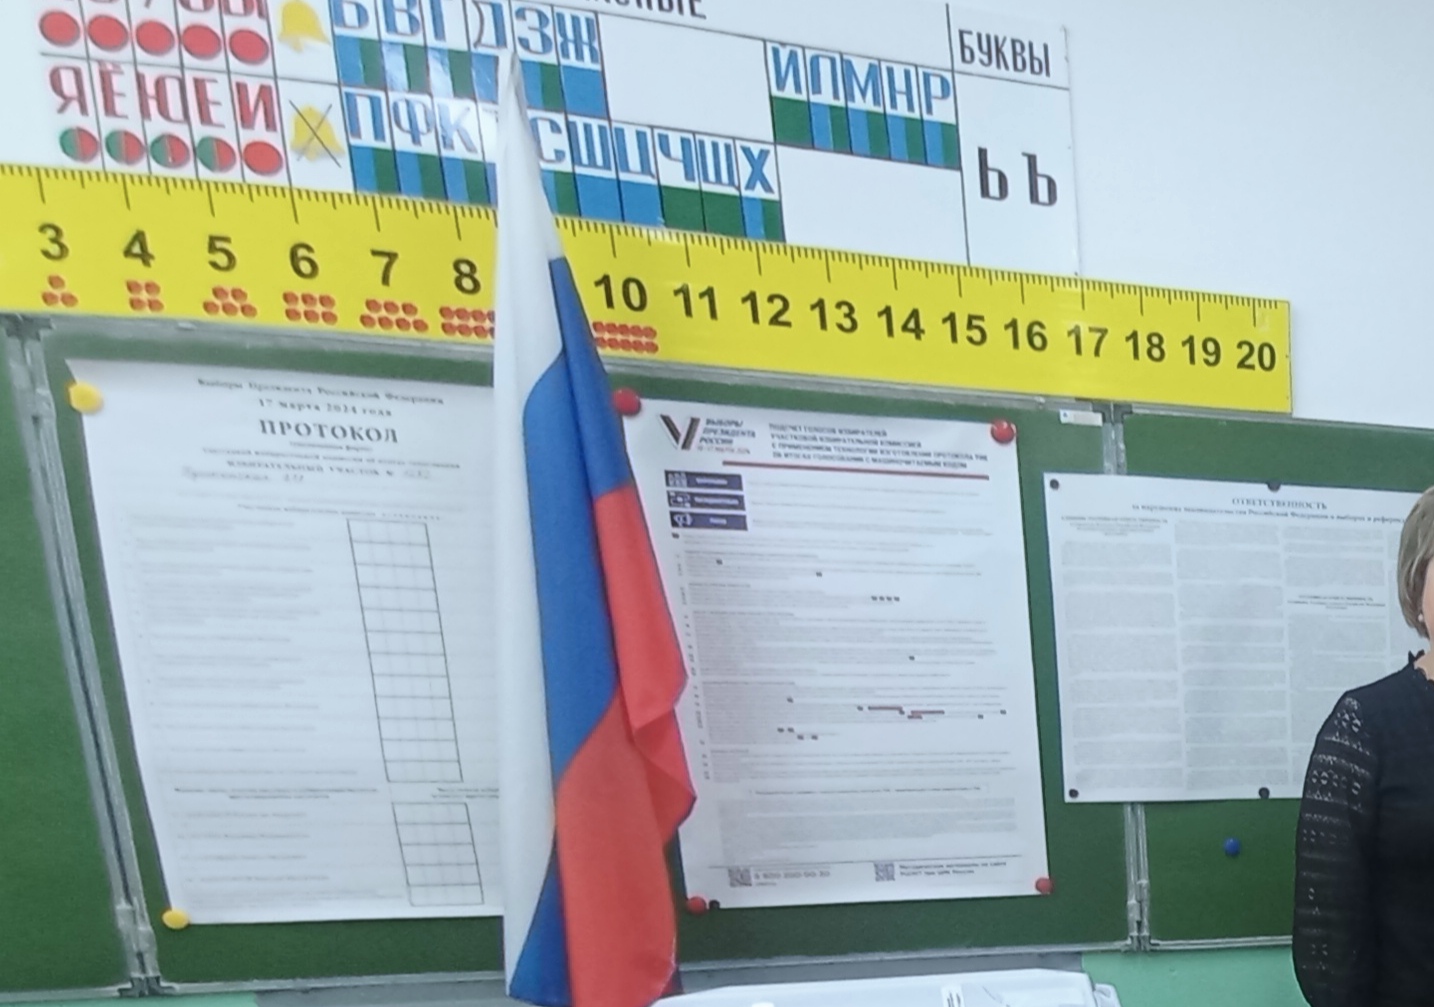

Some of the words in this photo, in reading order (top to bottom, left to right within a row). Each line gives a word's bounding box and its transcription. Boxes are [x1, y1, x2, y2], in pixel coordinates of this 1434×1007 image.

[958, 29, 1050, 78] БУКВЫ
[40, 223, 70, 261] 3
[123, 231, 153, 267] 4
[208, 235, 236, 271] 5
[290, 243, 319, 279] 6
[371, 250, 399, 286] 7
[453, 259, 482, 295] 8
[594, 274, 648, 312] 10
[673, 286, 718, 320] 11
[741, 291, 792, 328] 12
[810, 299, 858, 333] 13
[877, 305, 925, 340] 14
[942, 312, 988, 347] 15
[1004, 319, 1048, 352] 16
[1067, 325, 1109, 358] 17
[1125, 330, 1166, 363] 18
[1182, 336, 1222, 367] 19
[1236, 341, 1276, 372] 20
[259, 419, 398, 444] ПРОТОКОЛ
[1232, 497, 1327, 510] ОТВЕТСТВЕННОСТЬ
